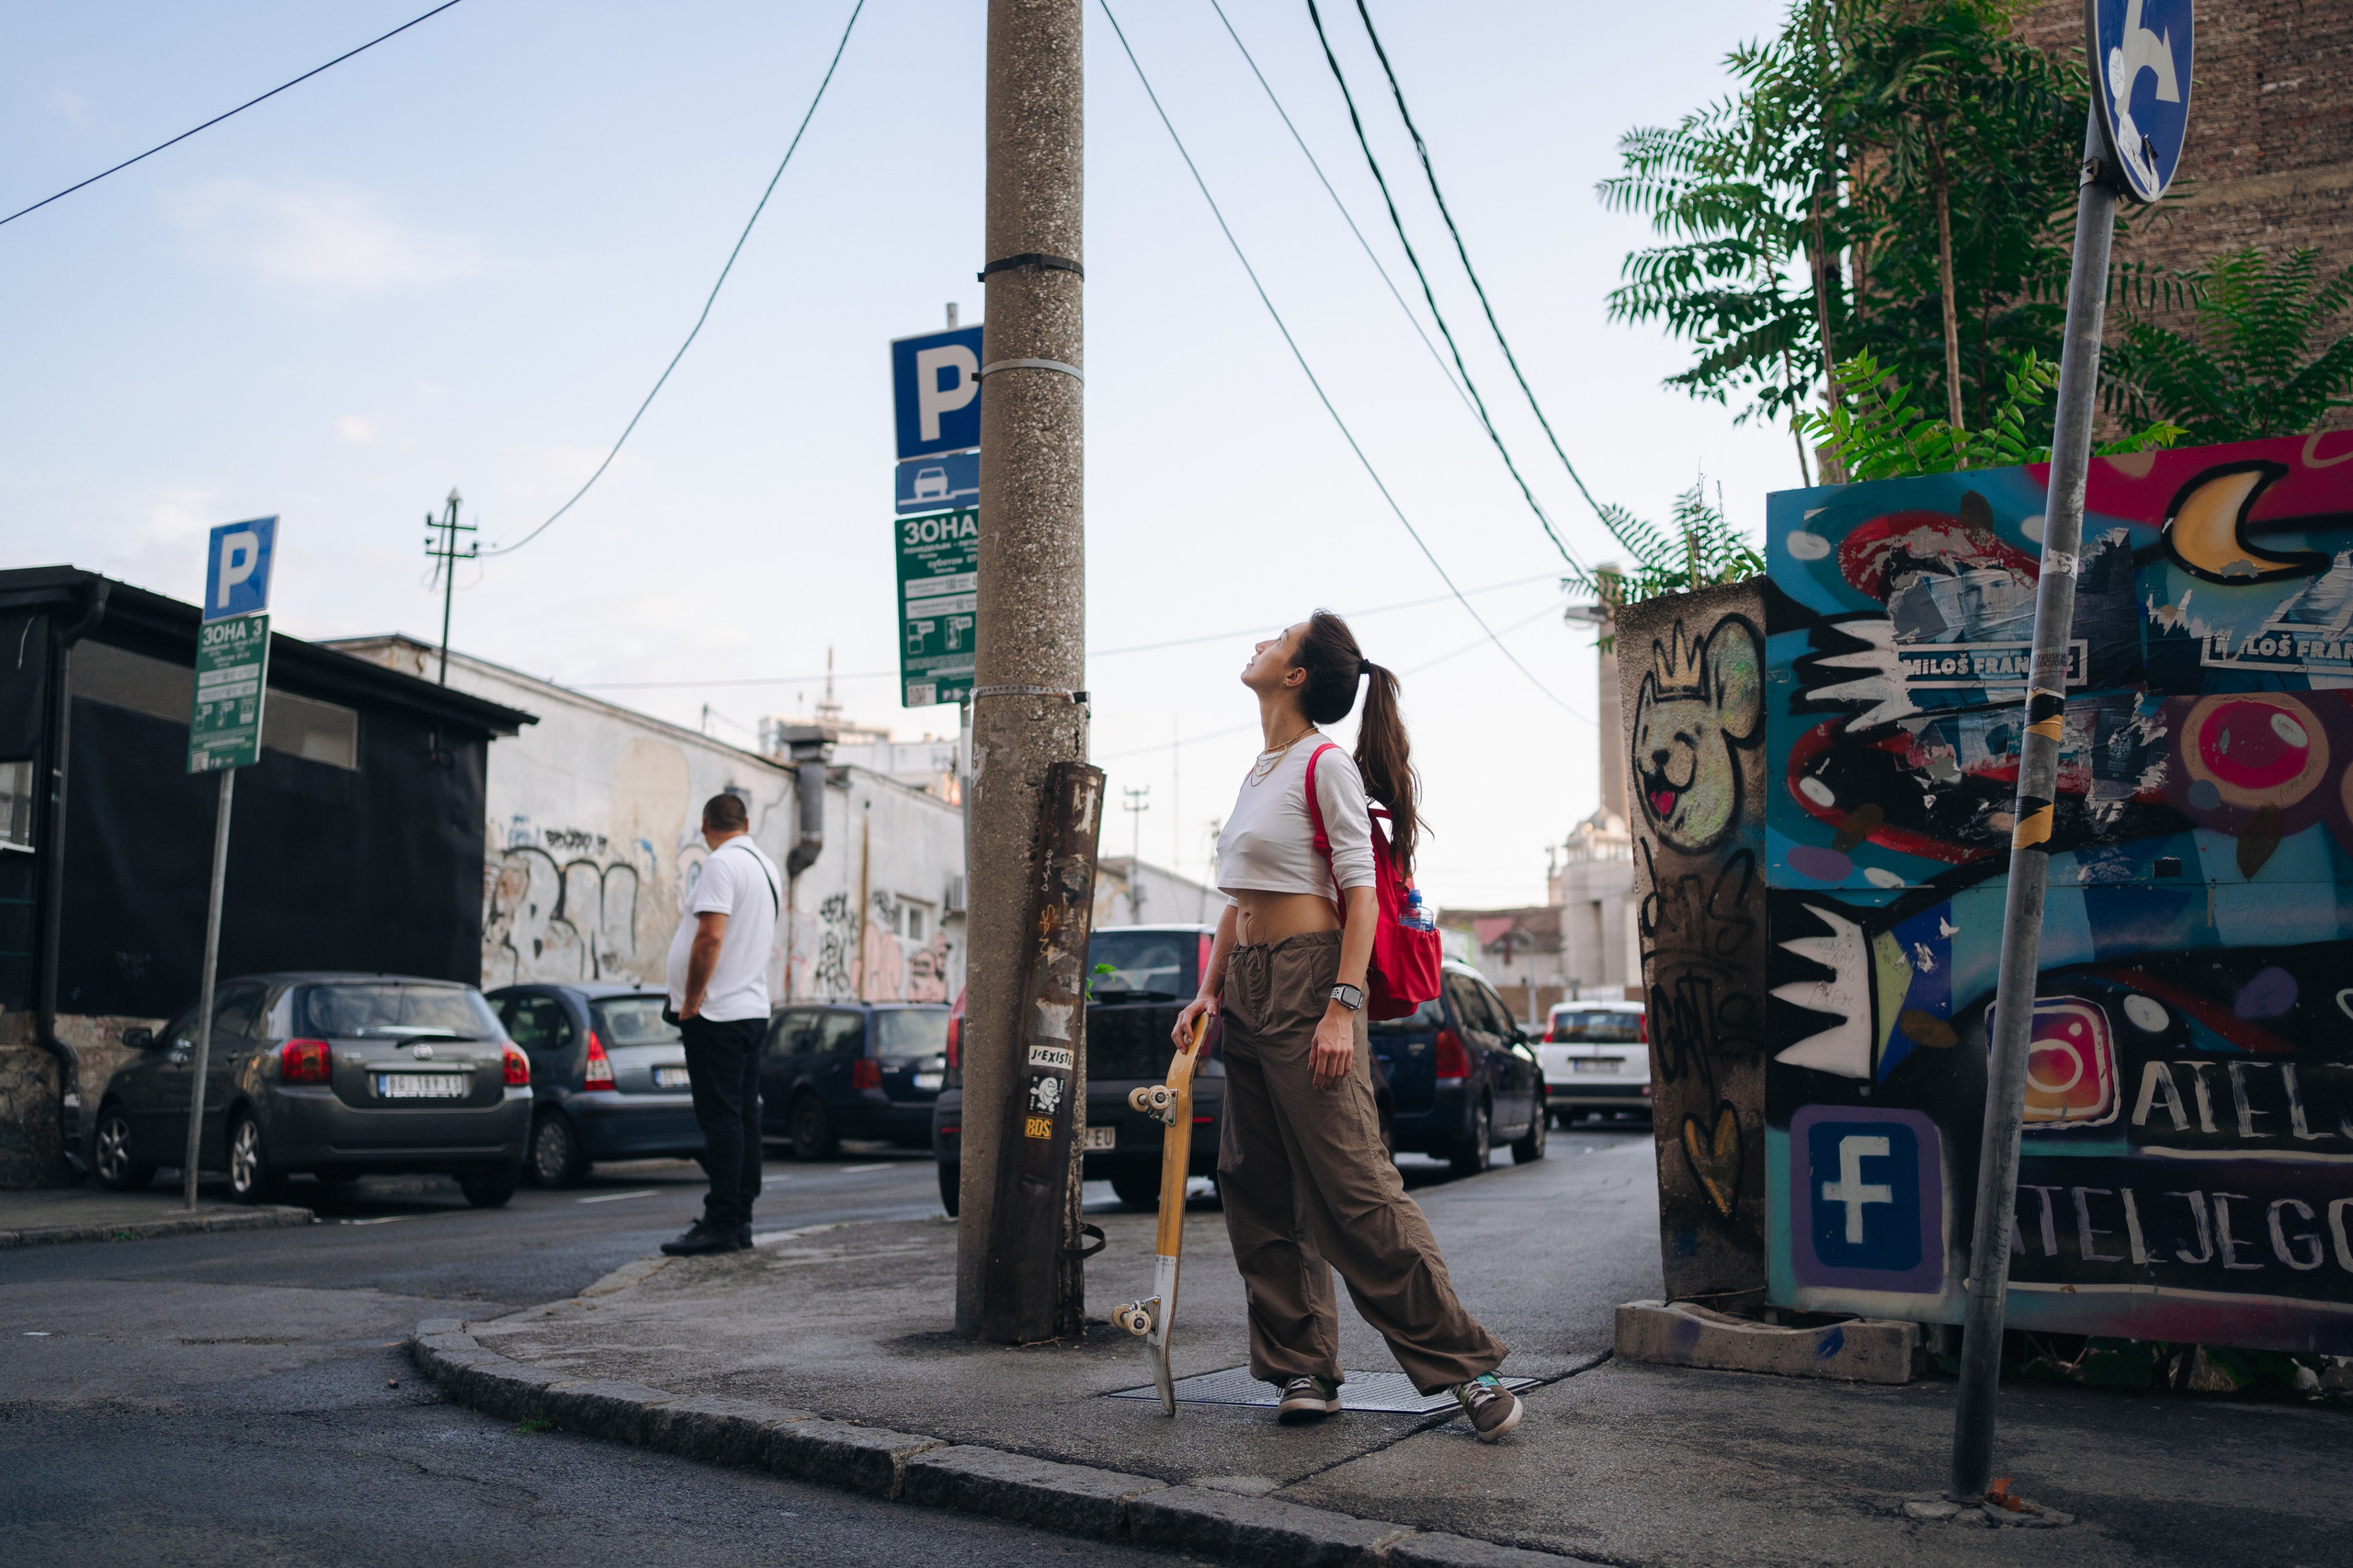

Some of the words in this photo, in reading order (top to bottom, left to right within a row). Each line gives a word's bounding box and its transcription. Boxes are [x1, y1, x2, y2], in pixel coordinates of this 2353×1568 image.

[916, 344, 979, 442] P
[904, 514, 978, 545] ЗОНА
[218, 530, 259, 608] P
[203, 621, 246, 646] ЗОНА
[253, 619, 263, 637] 3
[2296, 640, 2353, 660] FRA
[1030, 1049, 1073, 1065] J'EXISTE
[1027, 1118, 1051, 1138] BDS
[2009, 1184, 2353, 1274] TELJEG
